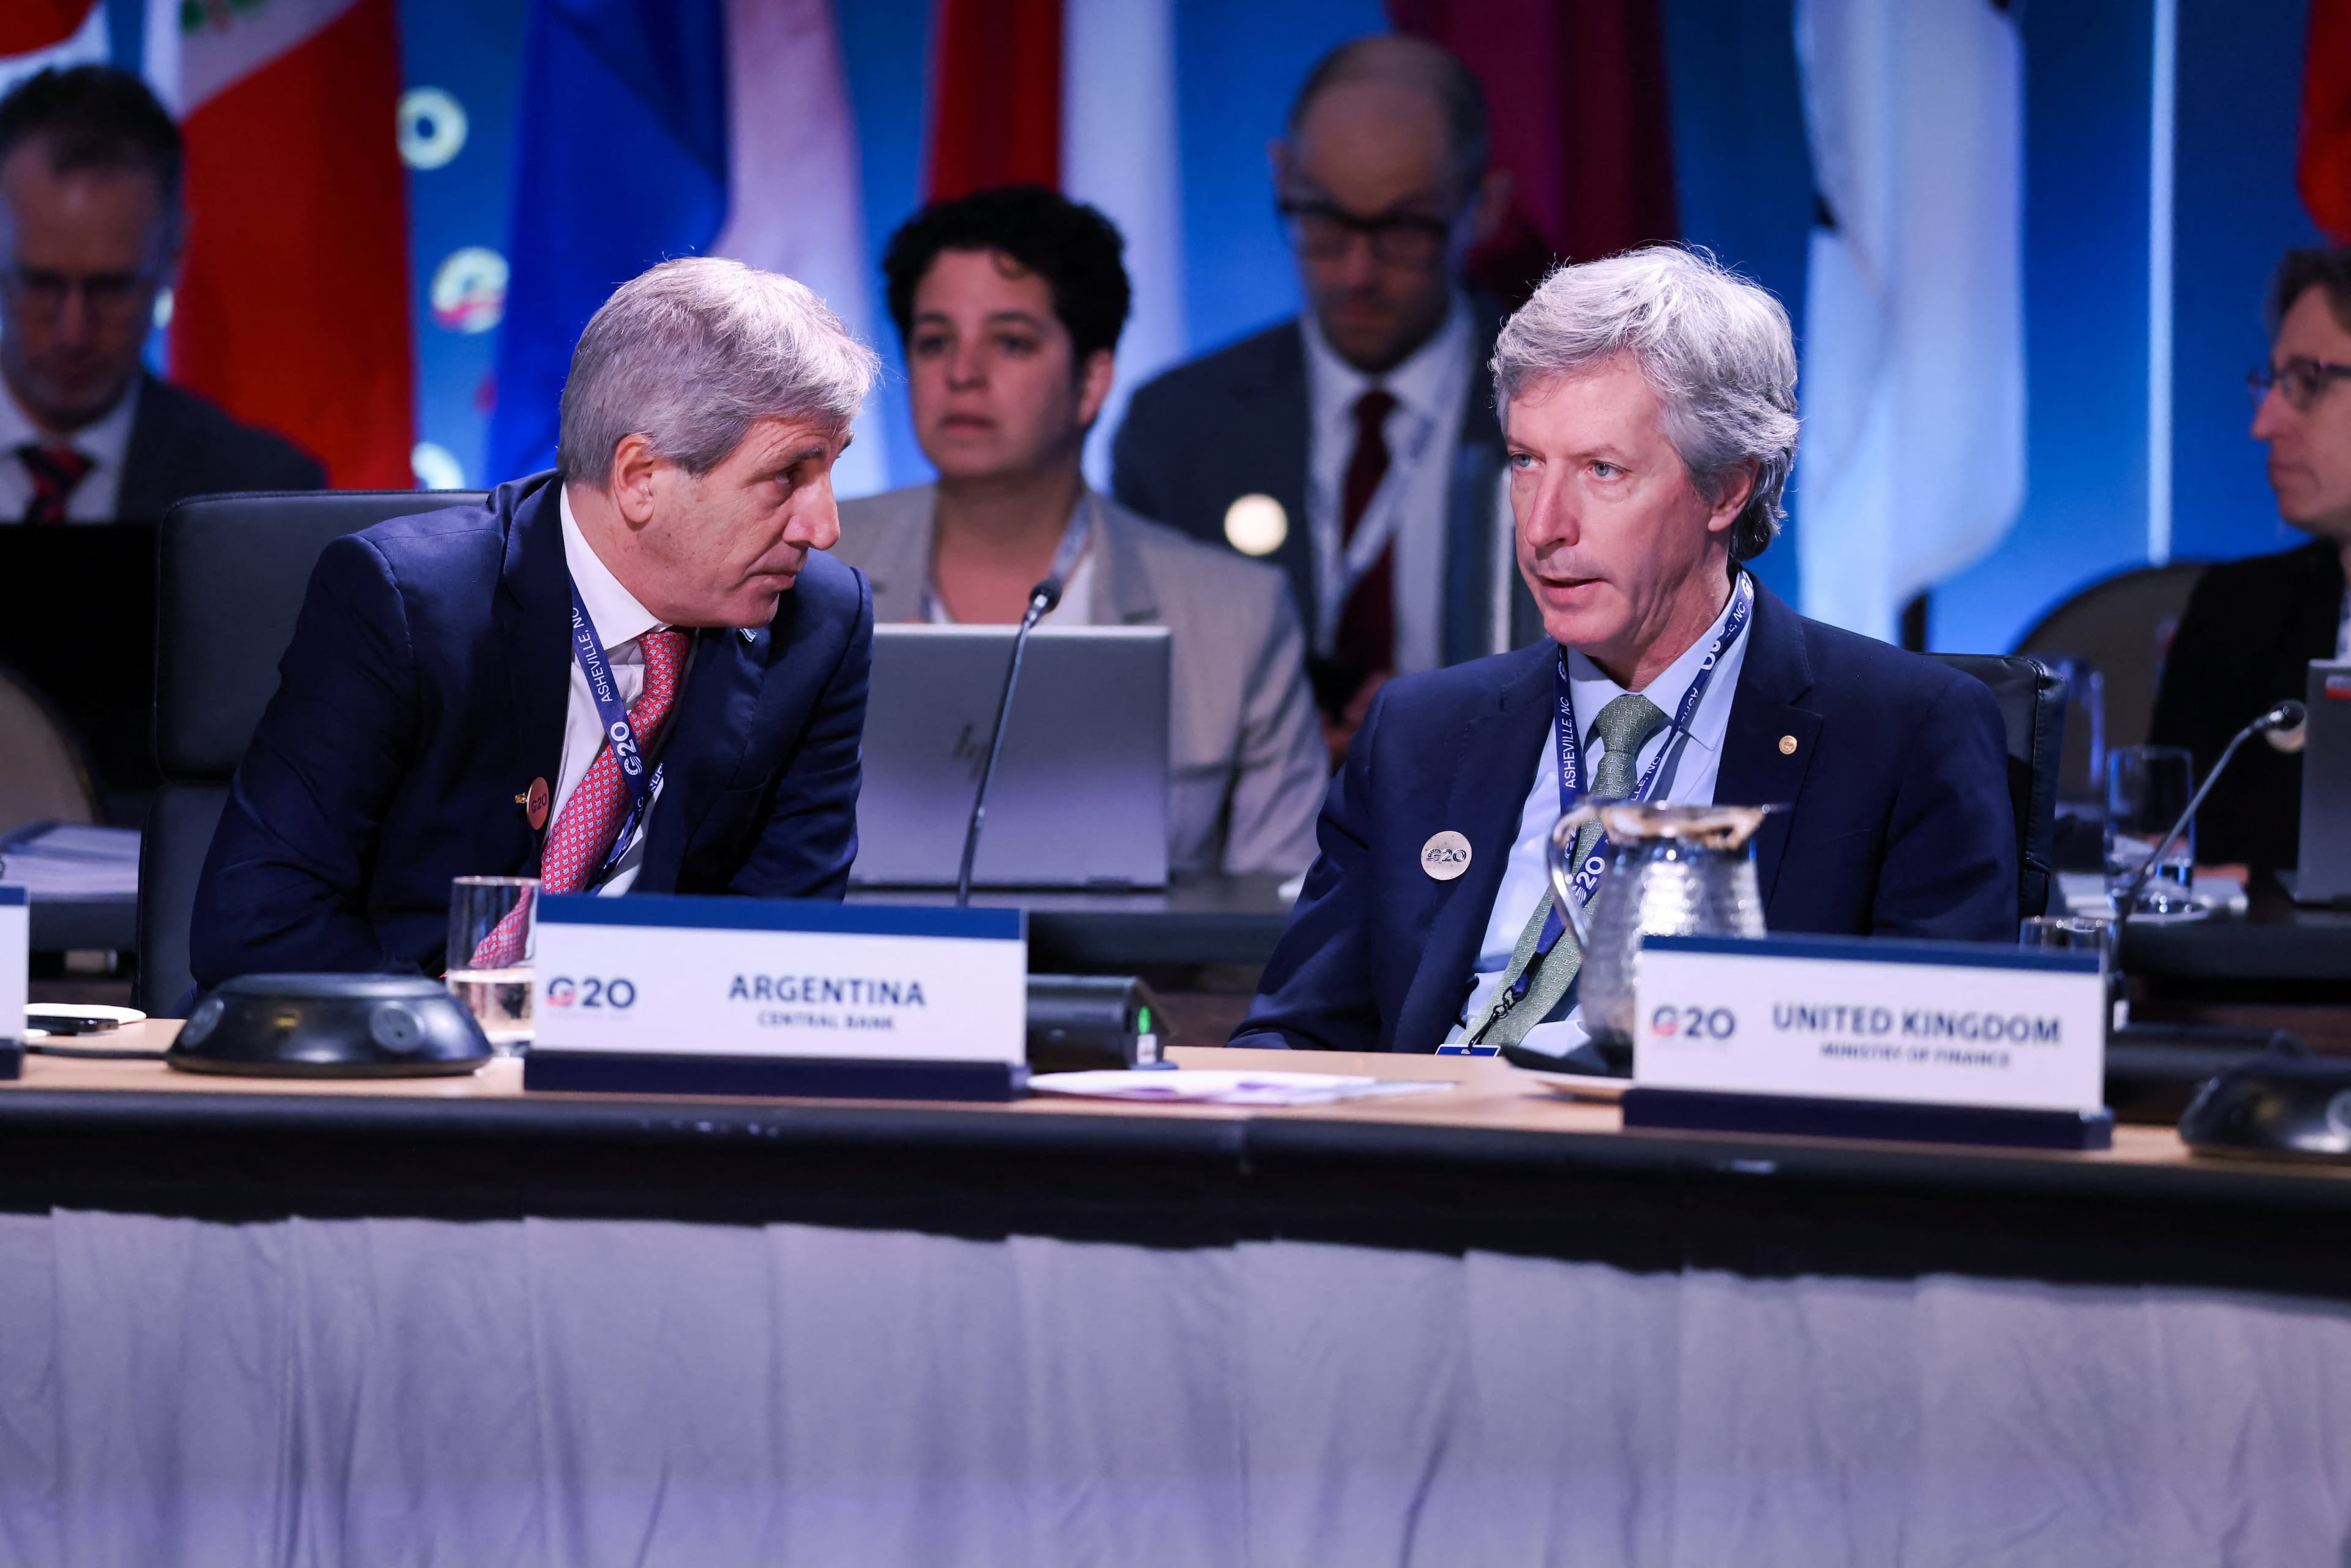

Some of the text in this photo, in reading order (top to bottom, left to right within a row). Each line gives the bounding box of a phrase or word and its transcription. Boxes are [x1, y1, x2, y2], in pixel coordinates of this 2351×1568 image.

[1733, 602, 1745, 622] NC
[577, 629, 613, 702] ASHEVILLE,
[1560, 697, 1571, 716] NC
[610, 721, 643, 776] G20
[1561, 718, 1577, 789] ASHEVILLE,
[531, 793, 547, 814] G20
[1427, 849, 1467, 862] G20
[545, 977, 636, 1009] G20
[729, 975, 926, 1006] ARGENTINA
[757, 1010, 894, 1029] CENTRAL BANK
[1651, 1005, 1735, 1040] G20
[1773, 1004, 2062, 1045] UNITED KINGDOM
[1821, 1041, 2011, 1067] MINISTRY OF FINANCE
